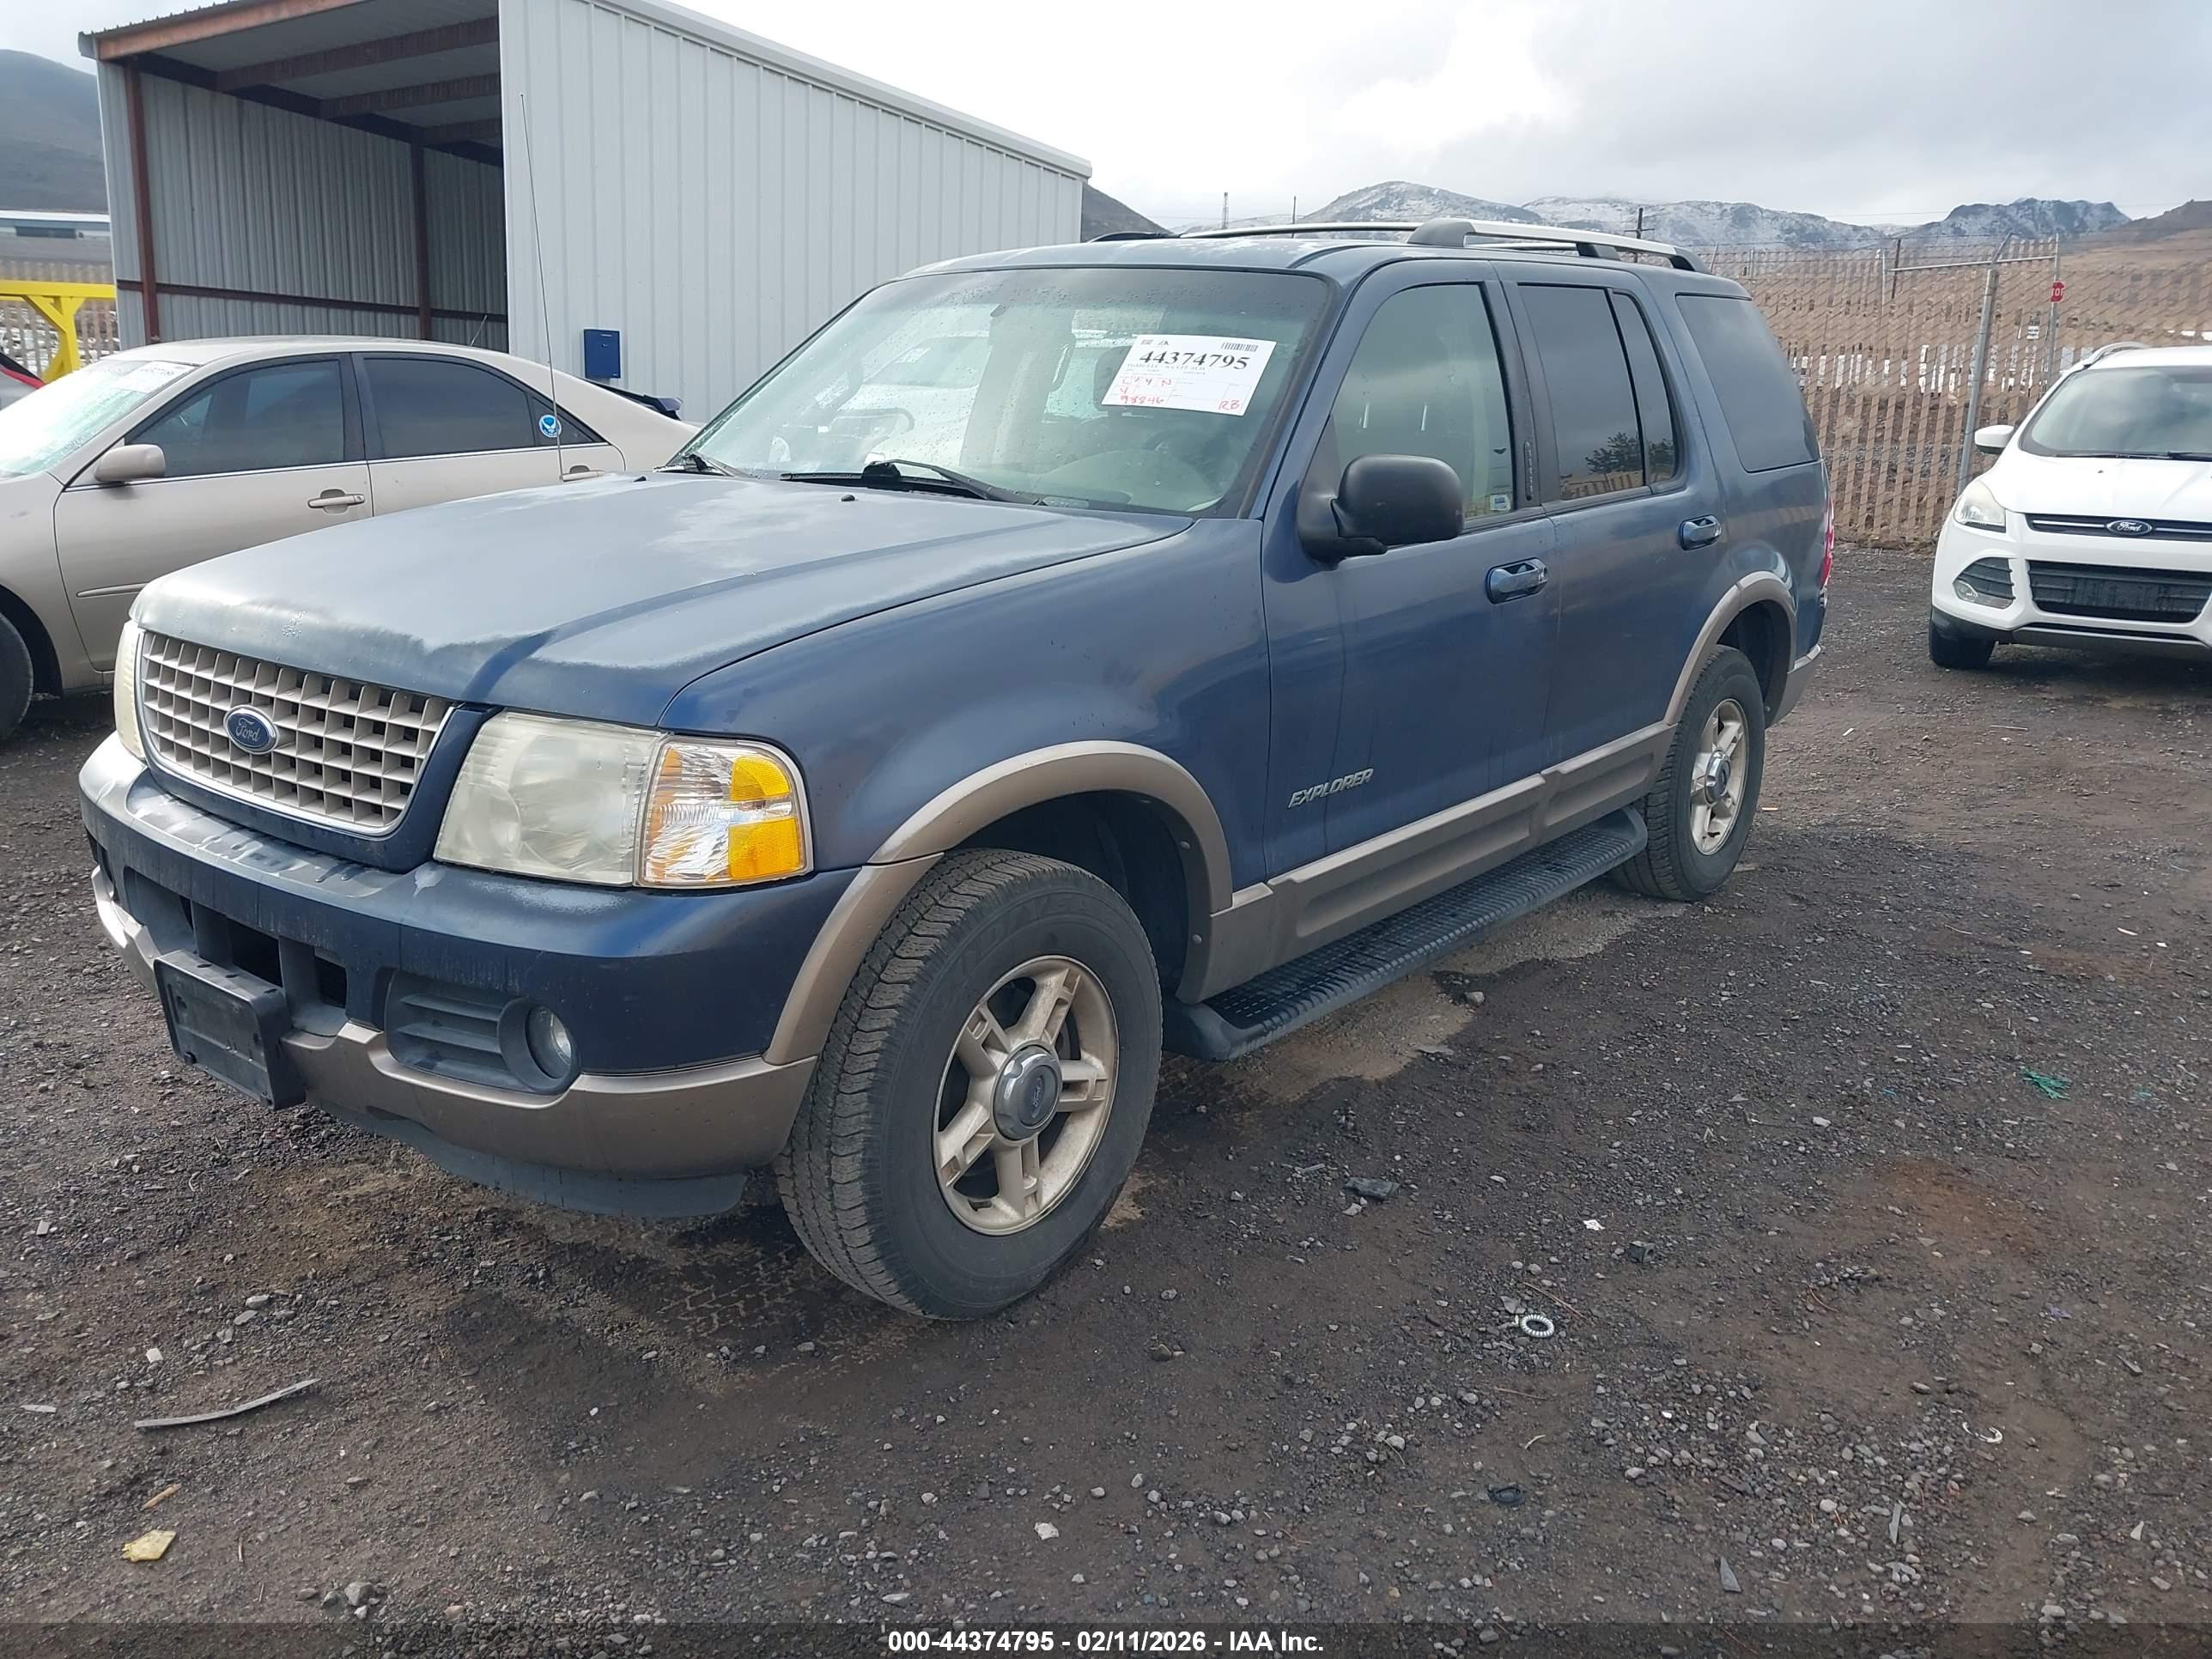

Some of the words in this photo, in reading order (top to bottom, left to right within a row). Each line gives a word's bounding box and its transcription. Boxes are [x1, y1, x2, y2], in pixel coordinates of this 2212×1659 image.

[1140, 350, 1251, 370] 44374795
[2117, 521, 2143, 532] Ford
[234, 717, 262, 742] Ford
[1287, 768, 1375, 809] EXPLORER
